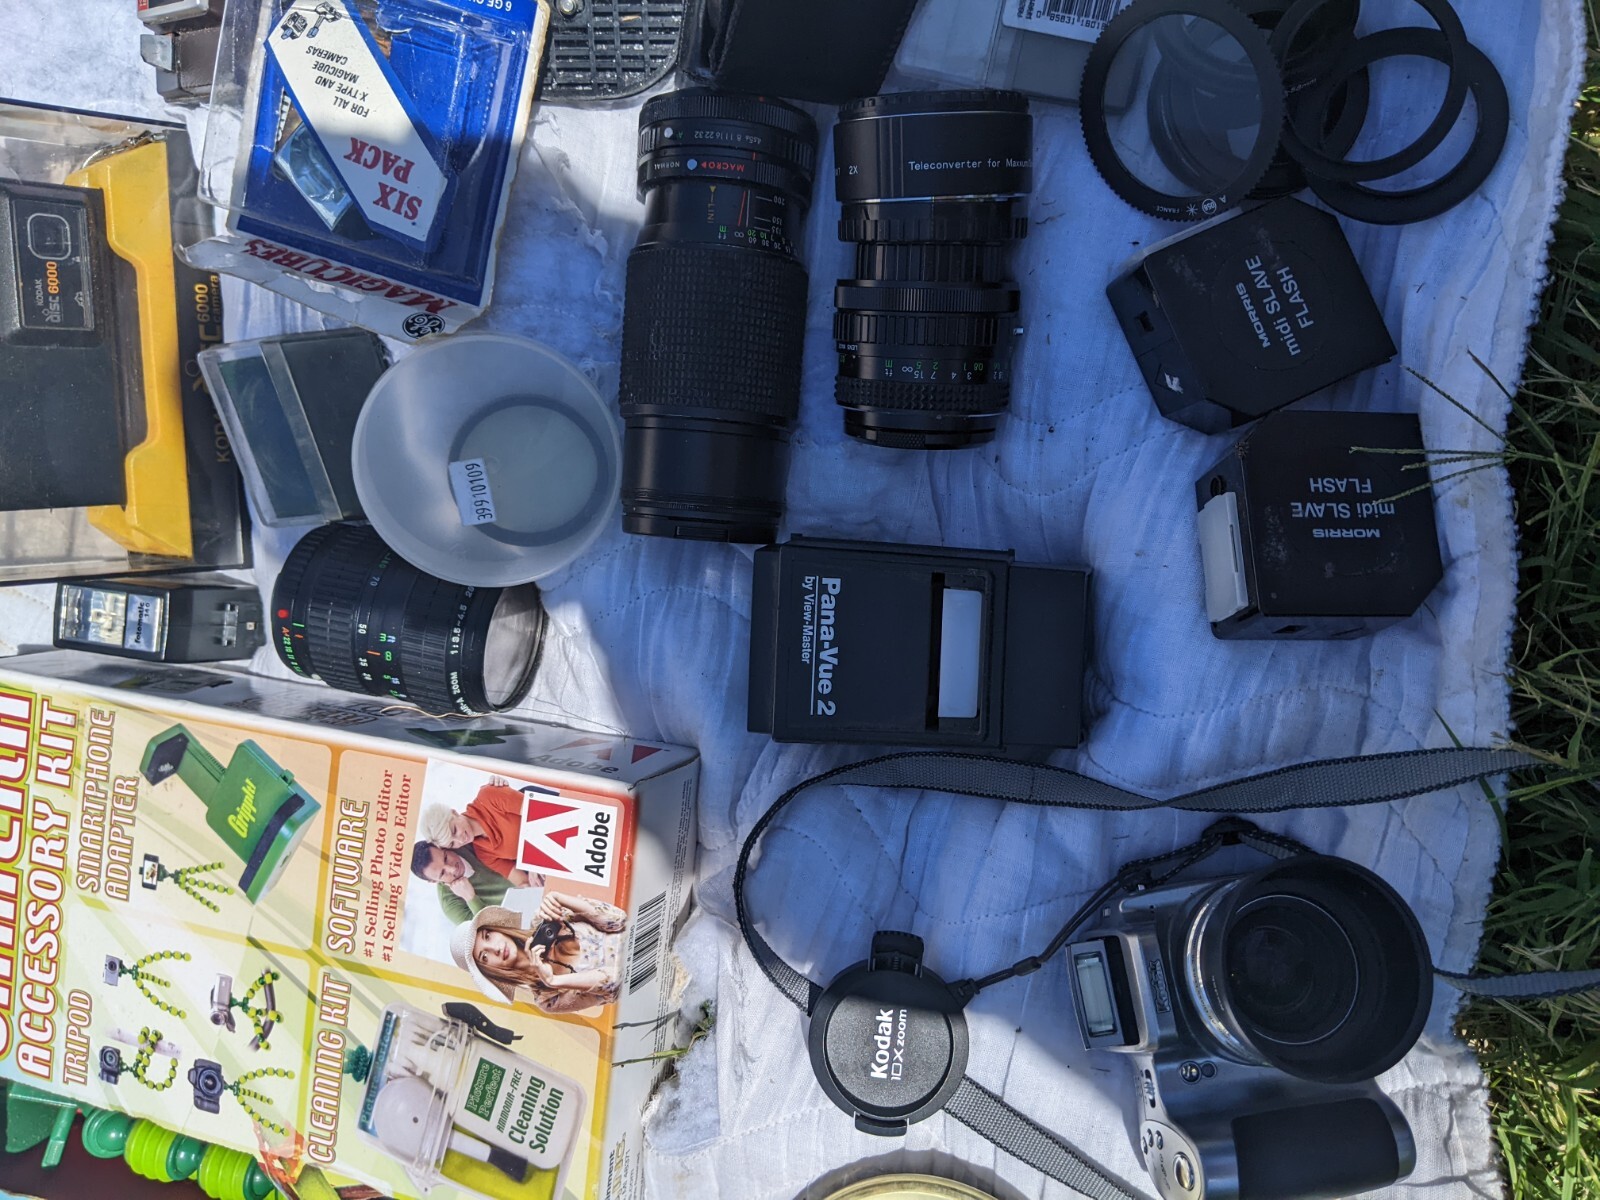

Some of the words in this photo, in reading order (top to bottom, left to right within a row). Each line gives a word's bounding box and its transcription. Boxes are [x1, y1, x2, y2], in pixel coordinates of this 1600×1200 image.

[305, 45, 348, 65] CAMERAS
[312, 60, 359, 83] MAGICUBE
[315, 76, 337, 91] AND
[332, 96, 348, 109] ALL
[339, 83, 368, 101] X-TYPE
[350, 102, 370, 118] FOR
[344, 137, 415, 184] PACK
[654, 160, 680, 171] NORMAL
[708, 161, 745, 172] MACRO
[848, 165, 859, 175] 2X
[908, 160, 984, 172] Teleconverter
[987, 159, 1001, 168] for
[373, 182, 423, 221] SIX
[1156, 205, 1180, 214] FRANCE
[34, 279, 42, 306] KODAK
[46, 261, 58, 294] 6000
[210, 274, 220, 324] camera
[245, 238, 459, 315] MAGICUBES
[1245, 254, 1284, 314] SLAVE
[1276, 265, 1315, 330] FLASH
[42, 296, 61, 324] disc
[195, 283, 210, 324] 6000
[1235, 281, 1271, 348] MORRIS
[1274, 316, 1301, 357] midi
[464, 462, 493, 521] 39910109
[1309, 477, 1373, 494] FLASH
[1291, 502, 1351, 518] SLAVE
[1356, 501, 1395, 518] midi
[1312, 528, 1381, 538] MORRIS
[803, 576, 815, 590] by
[135, 602, 145, 644] fotomatic
[358, 623, 368, 634] 50
[801, 591, 814, 664] View-Master
[817, 577, 842, 695] Pana-Vue
[450, 671, 460, 695] ZOOM
[816, 700, 836, 716] 2
[35, 694, 80, 789] KIT
[531, 752, 619, 776] Adobe
[75, 706, 116, 895] SMARTPHONE
[376, 769, 394, 825] Editor
[394, 774, 412, 829] Editor
[104, 775, 140, 903] ADAPTER
[371, 828, 387, 875] Photo
[390, 834, 406, 880] Video
[583, 811, 611, 878] Adobe
[325, 798, 370, 956] SOFTWARE
[363, 878, 381, 932] Selling
[382, 882, 403, 936] Selling
[15, 796, 70, 1082] ACCESSORY
[362, 935, 375, 959] #1
[381, 938, 395, 963] #1
[325, 972, 353, 1027] KIT
[63, 988, 94, 1087] TRIPOD
[870, 1009, 894, 1079] Kodak
[896, 1009, 908, 1047] zoom
[307, 1028, 346, 1164] CLEANING
[360, 1077, 381, 1127] Picture
[467, 1062, 491, 1112] Picture
[478, 1066, 504, 1121] Perfect
[496, 1068, 524, 1134] AMMONIA-FREE
[508, 1075, 547, 1144] Cleaning
[529, 1087, 565, 1155] Solution
